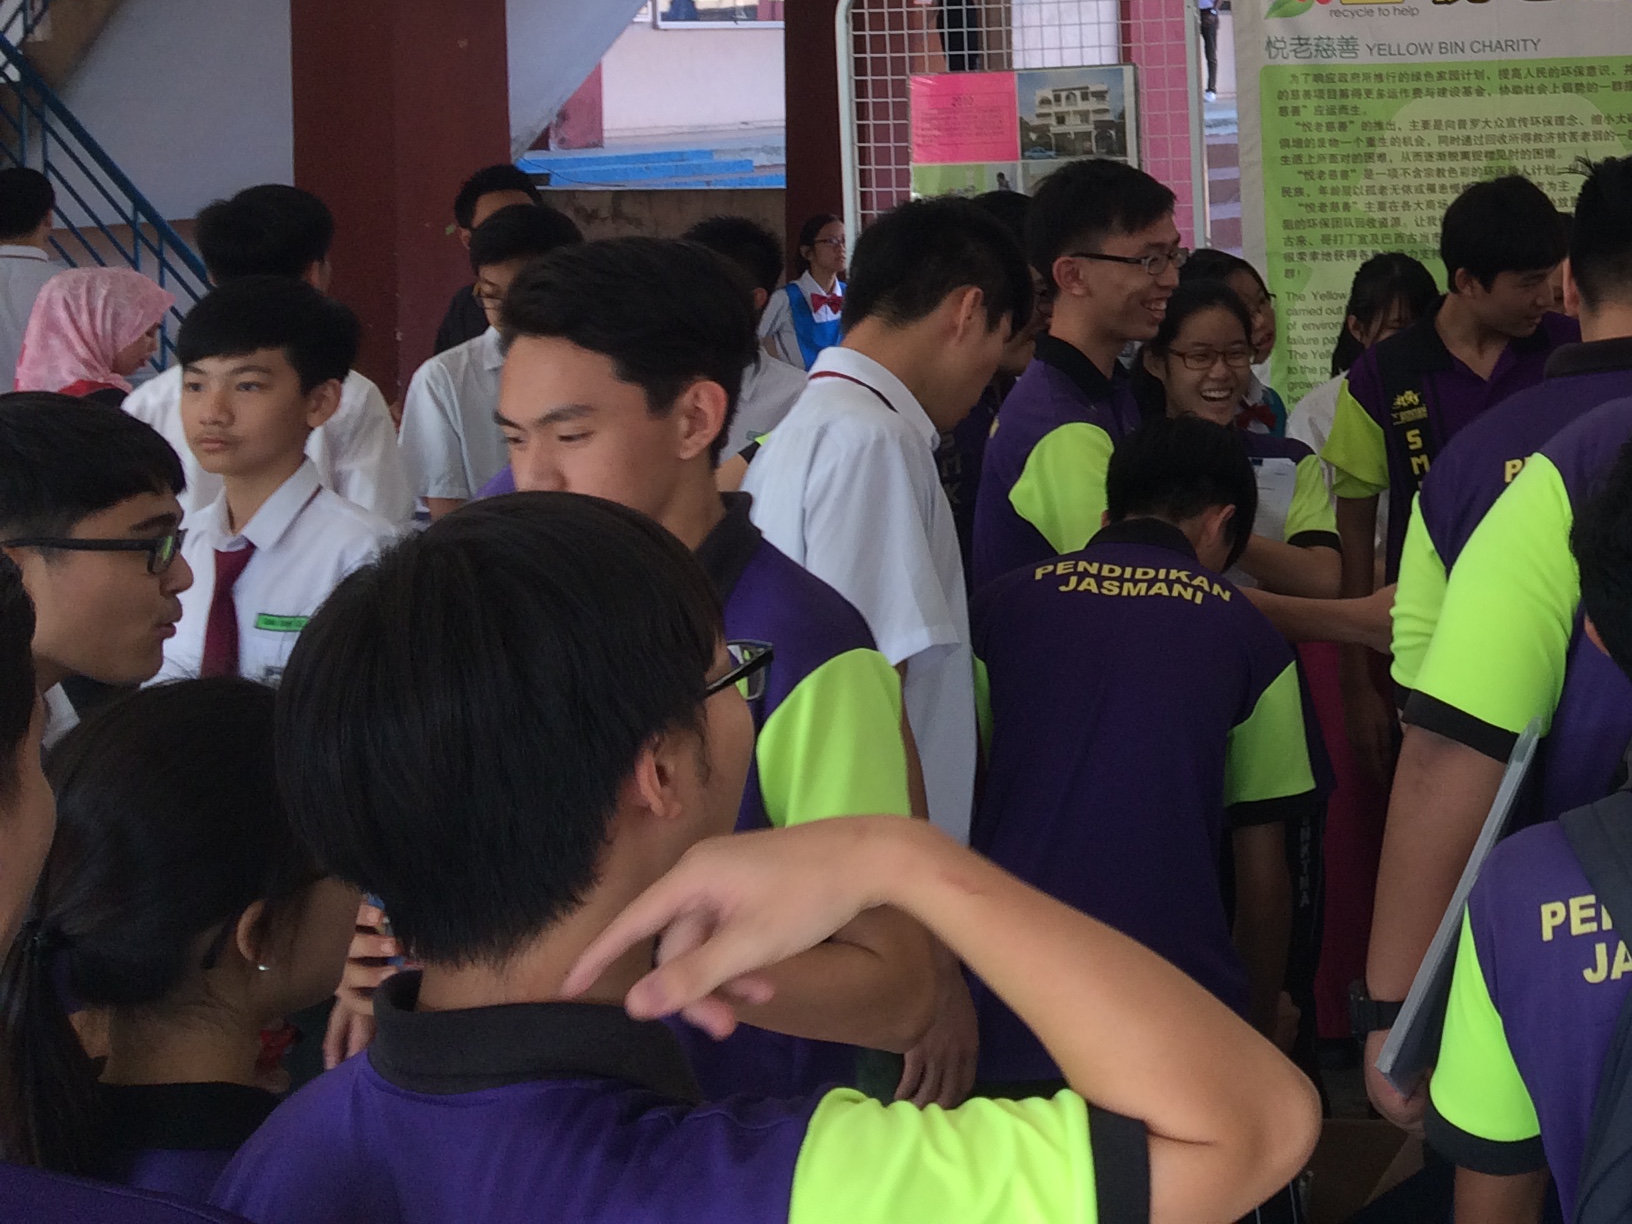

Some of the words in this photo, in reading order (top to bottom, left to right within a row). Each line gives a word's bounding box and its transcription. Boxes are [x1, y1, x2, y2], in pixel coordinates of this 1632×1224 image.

[1329, 7, 1374, 19] recycle
[1377, 7, 1391, 17] to
[1392, 5, 1419, 17] help
[1264, 34, 1360, 60] 悦老慈善
[1365, 42, 1434, 57] YELLOW
[1438, 40, 1465, 55] BIN
[1470, 38, 1542, 55] CHARITY
[1286, 291, 1306, 302] The
[1311, 290, 1347, 301] Yellow
[1286, 306, 1323, 316] carried
[1325, 306, 1344, 316] out
[1301, 321, 1342, 332] environ
[1286, 336, 1320, 346] failure
[1288, 350, 1308, 360] The
[1310, 350, 1332, 360] Yell
[1035, 560, 1232, 603] PENDIDIKAN
[1059, 574, 1204, 605] JASMANI
